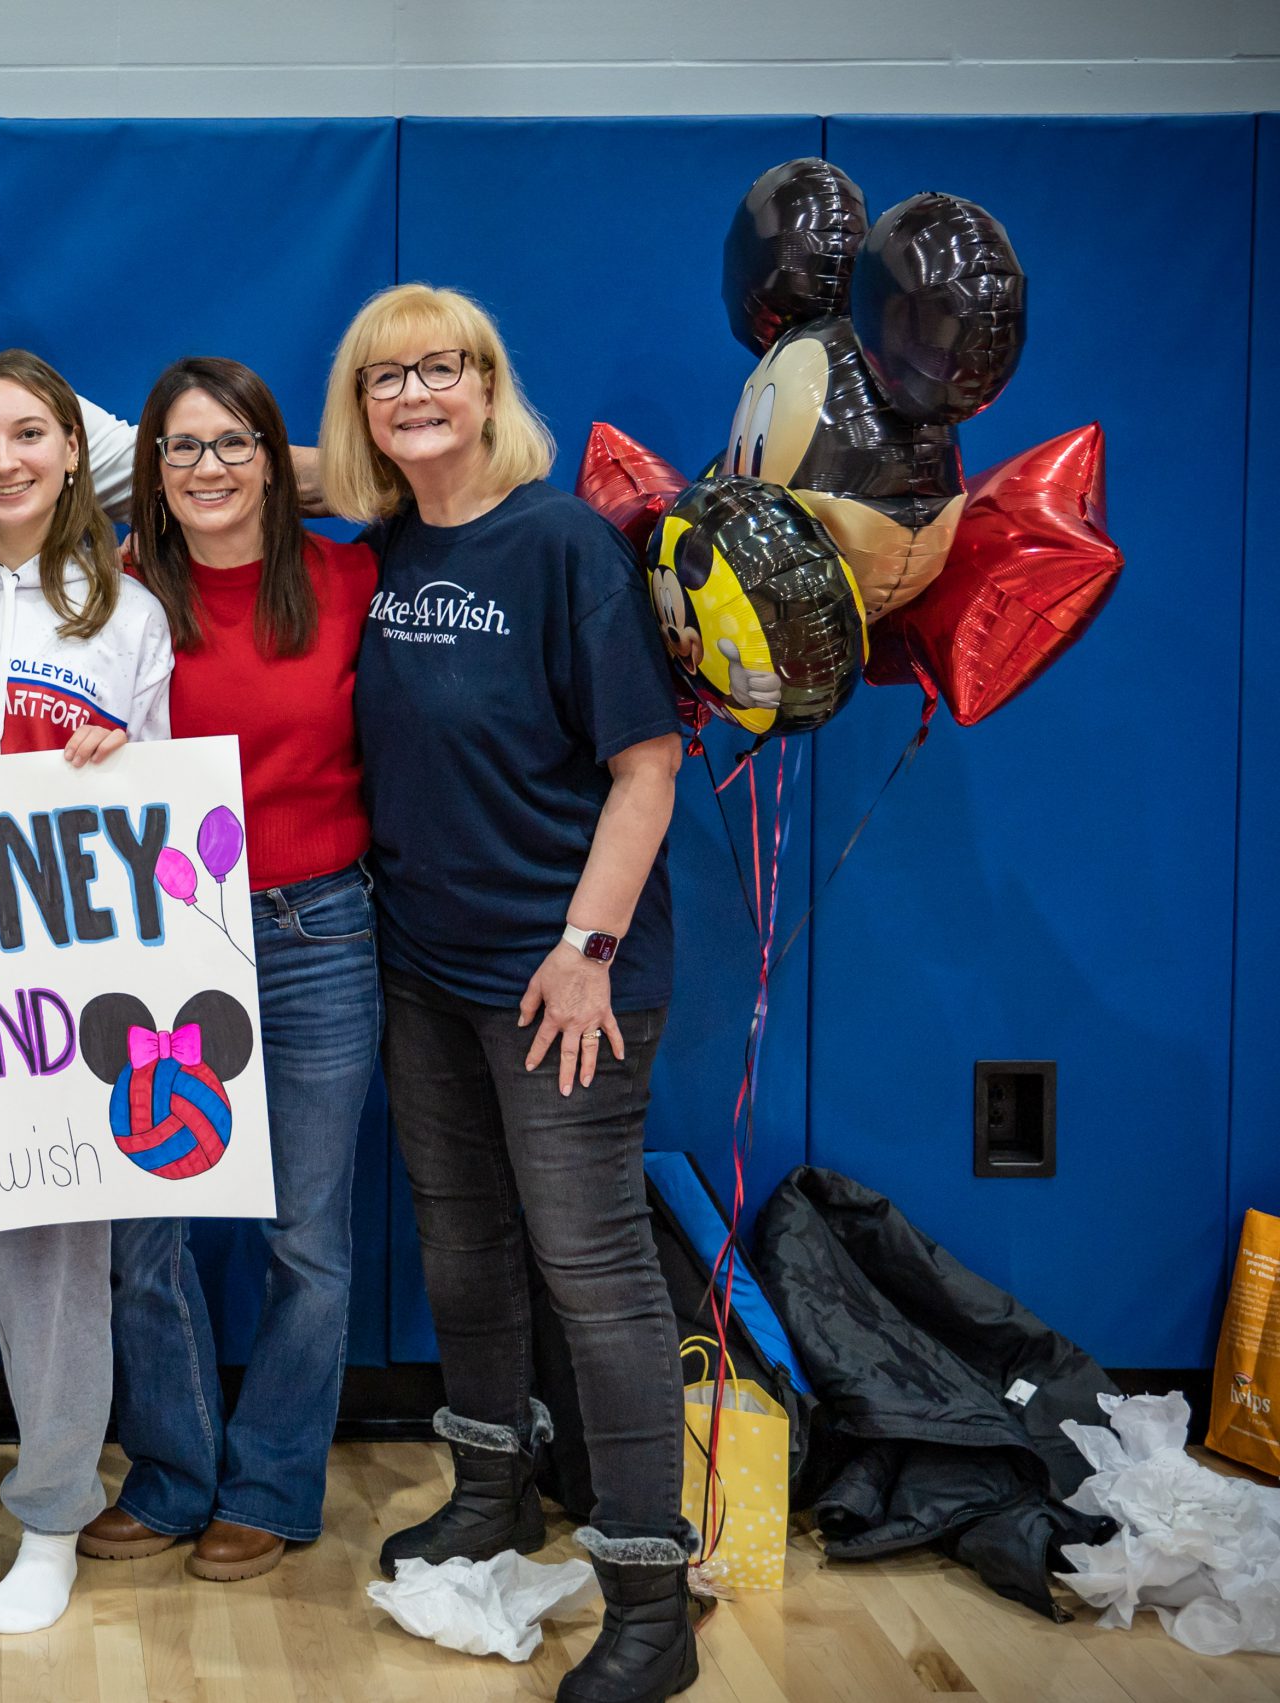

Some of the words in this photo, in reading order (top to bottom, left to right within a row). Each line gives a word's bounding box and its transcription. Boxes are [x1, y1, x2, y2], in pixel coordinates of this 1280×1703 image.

[382, 627, 413, 642] ENTRAL
[413, 632, 432, 643] NEW
[431, 633, 458, 645] YORK
[9, 658, 97, 698] OLLEYBALL
[1230, 1383, 1271, 1415] helps
